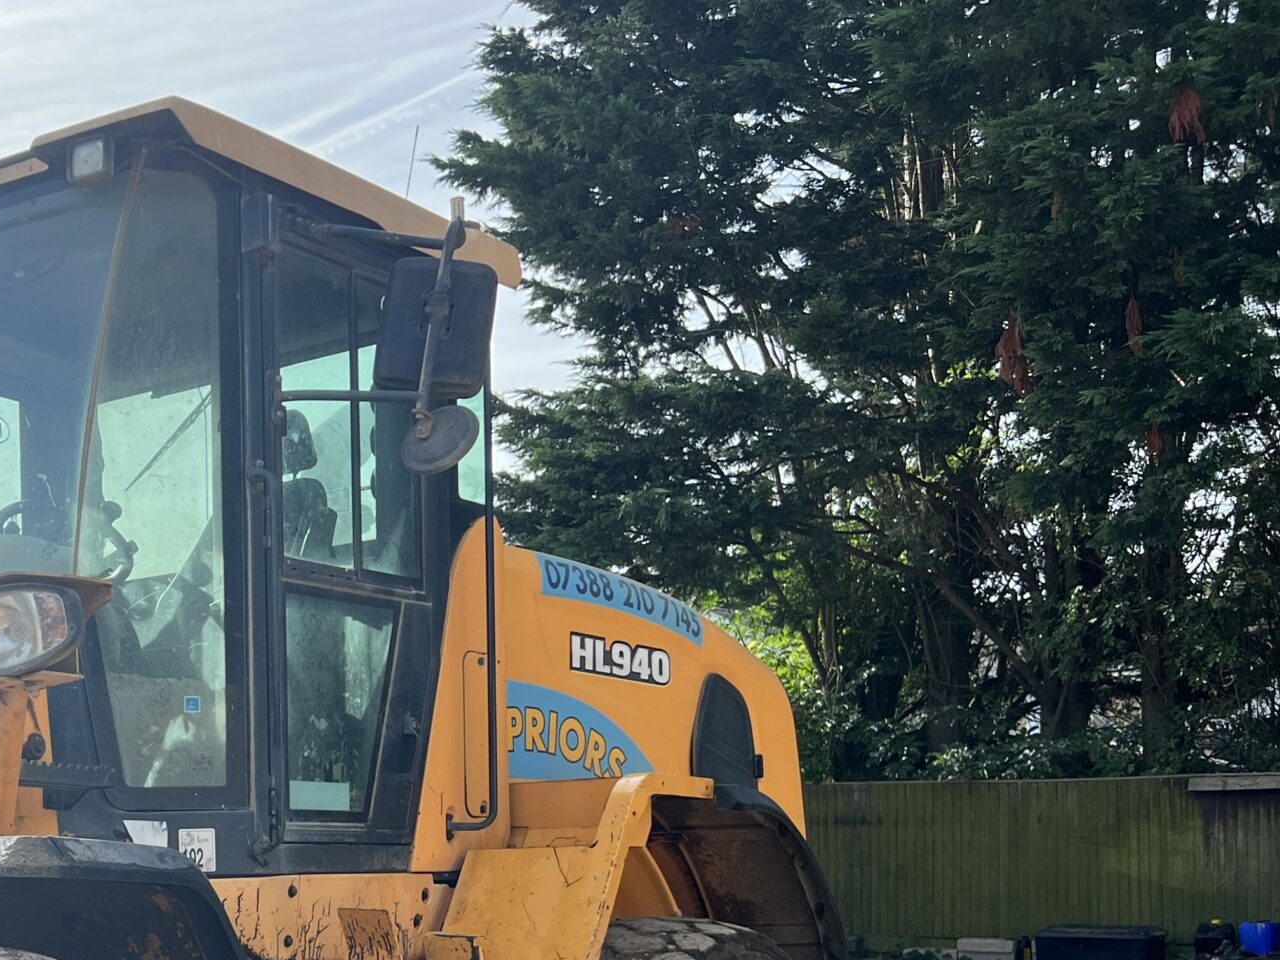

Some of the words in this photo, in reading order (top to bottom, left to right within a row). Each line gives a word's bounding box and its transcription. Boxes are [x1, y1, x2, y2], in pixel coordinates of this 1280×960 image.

[545, 560, 614, 601] 07388
[619, 580, 655, 615] 210
[658, 594, 701, 638] 7145
[571, 632, 670, 685] HL940
[506, 706, 627, 778] PRIORS
